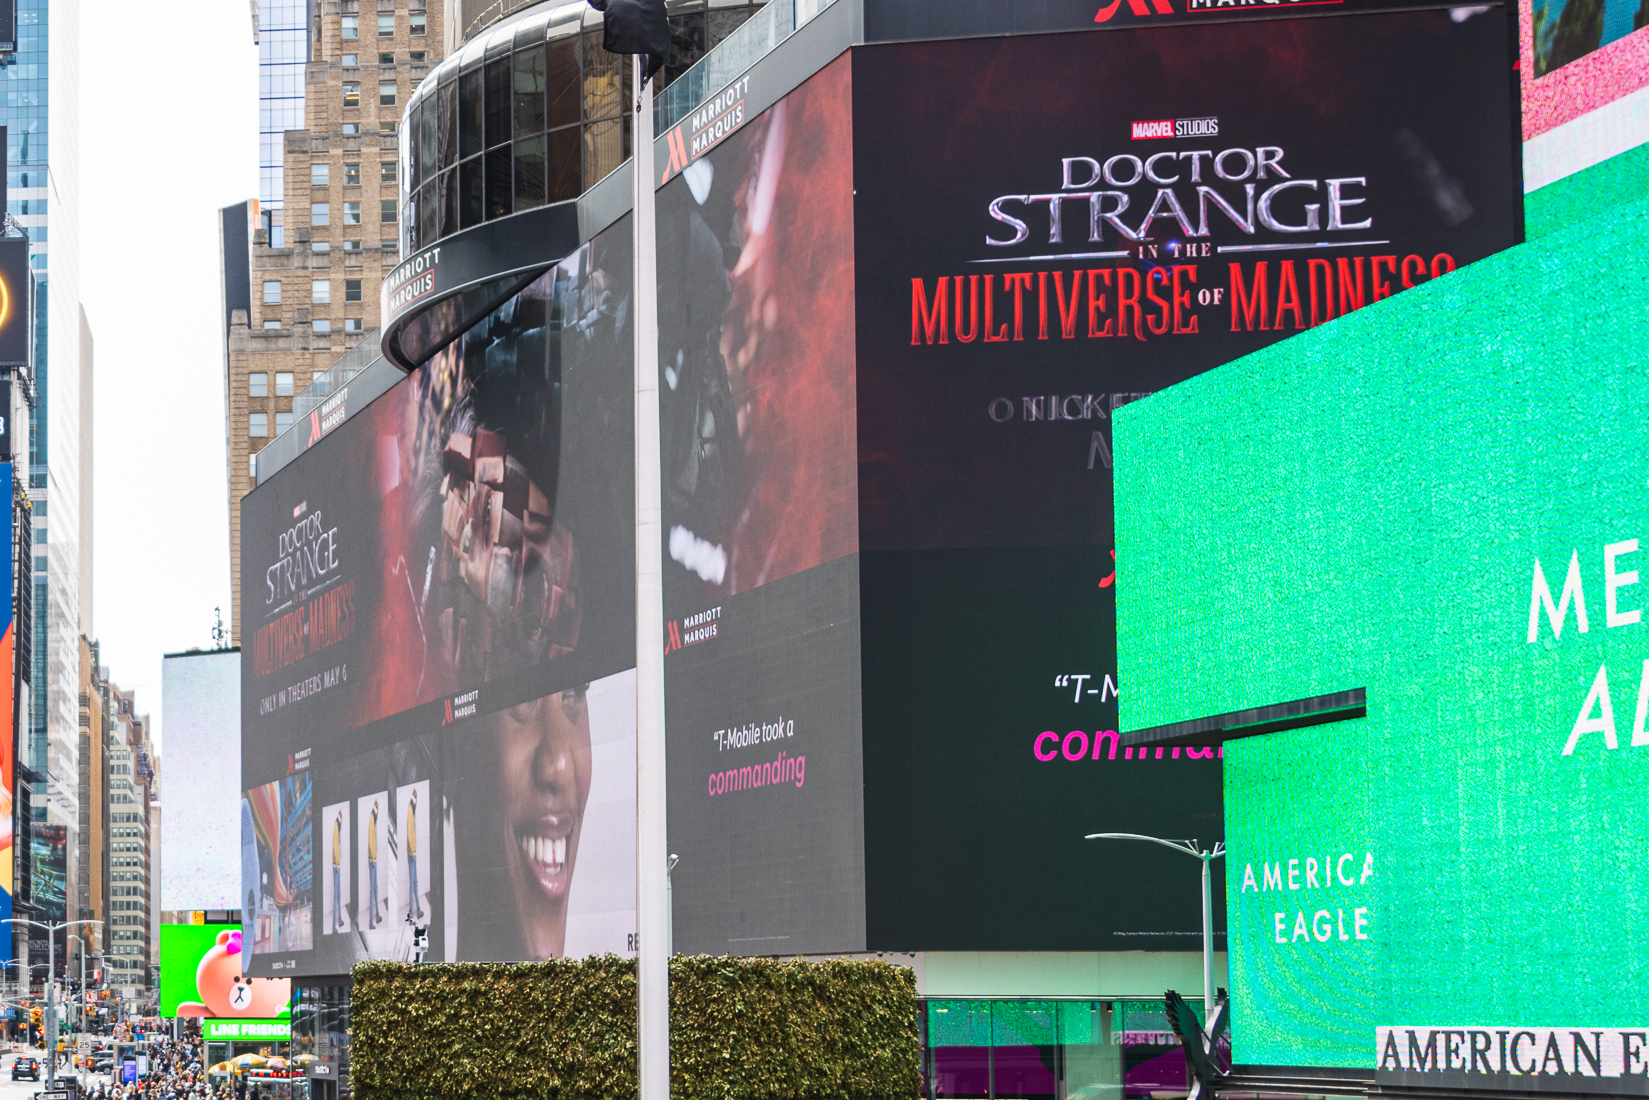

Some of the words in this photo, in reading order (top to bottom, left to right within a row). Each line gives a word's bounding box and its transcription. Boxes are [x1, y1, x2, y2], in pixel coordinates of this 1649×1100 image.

[692, 75, 750, 133] MARRIOTT
[692, 104, 744, 157] MARQUIS
[1132, 121, 1174, 138] MARVEL
[1175, 118, 1219, 135] STUDIOS
[1061, 145, 1291, 192] DOCTOR
[986, 175, 1372, 248] STRANGE
[1138, 244, 1158, 259] IN
[1173, 242, 1211, 258] THE
[389, 247, 441, 290] MARRIOTT
[390, 273, 433, 313] MARQUIS
[910, 266, 1199, 346] MULTIVERSE
[1198, 286, 1224, 306] OF
[322, 387, 348, 417] MARRIOTT
[322, 406, 345, 433] MARQUIS
[279, 510, 322, 558] DOCTOR
[266, 527, 338, 604] STRANGE
[684, 607, 721, 629] MARRIOTT
[684, 625, 717, 644] MARQUIS
[288, 674, 321, 703] THEATERS
[324, 669, 341, 689] MAY
[455, 690, 479, 706] MARRIOTT
[455, 704, 476, 718] MARQUIS
[762, 716, 784, 741] took
[786, 721, 794, 737] a
[708, 750, 806, 796] commanding
[1275, 908, 1368, 943] EAGLE
[211, 1025, 240, 1035] LINE
[1381, 1031, 1603, 1077] AMERICAN
